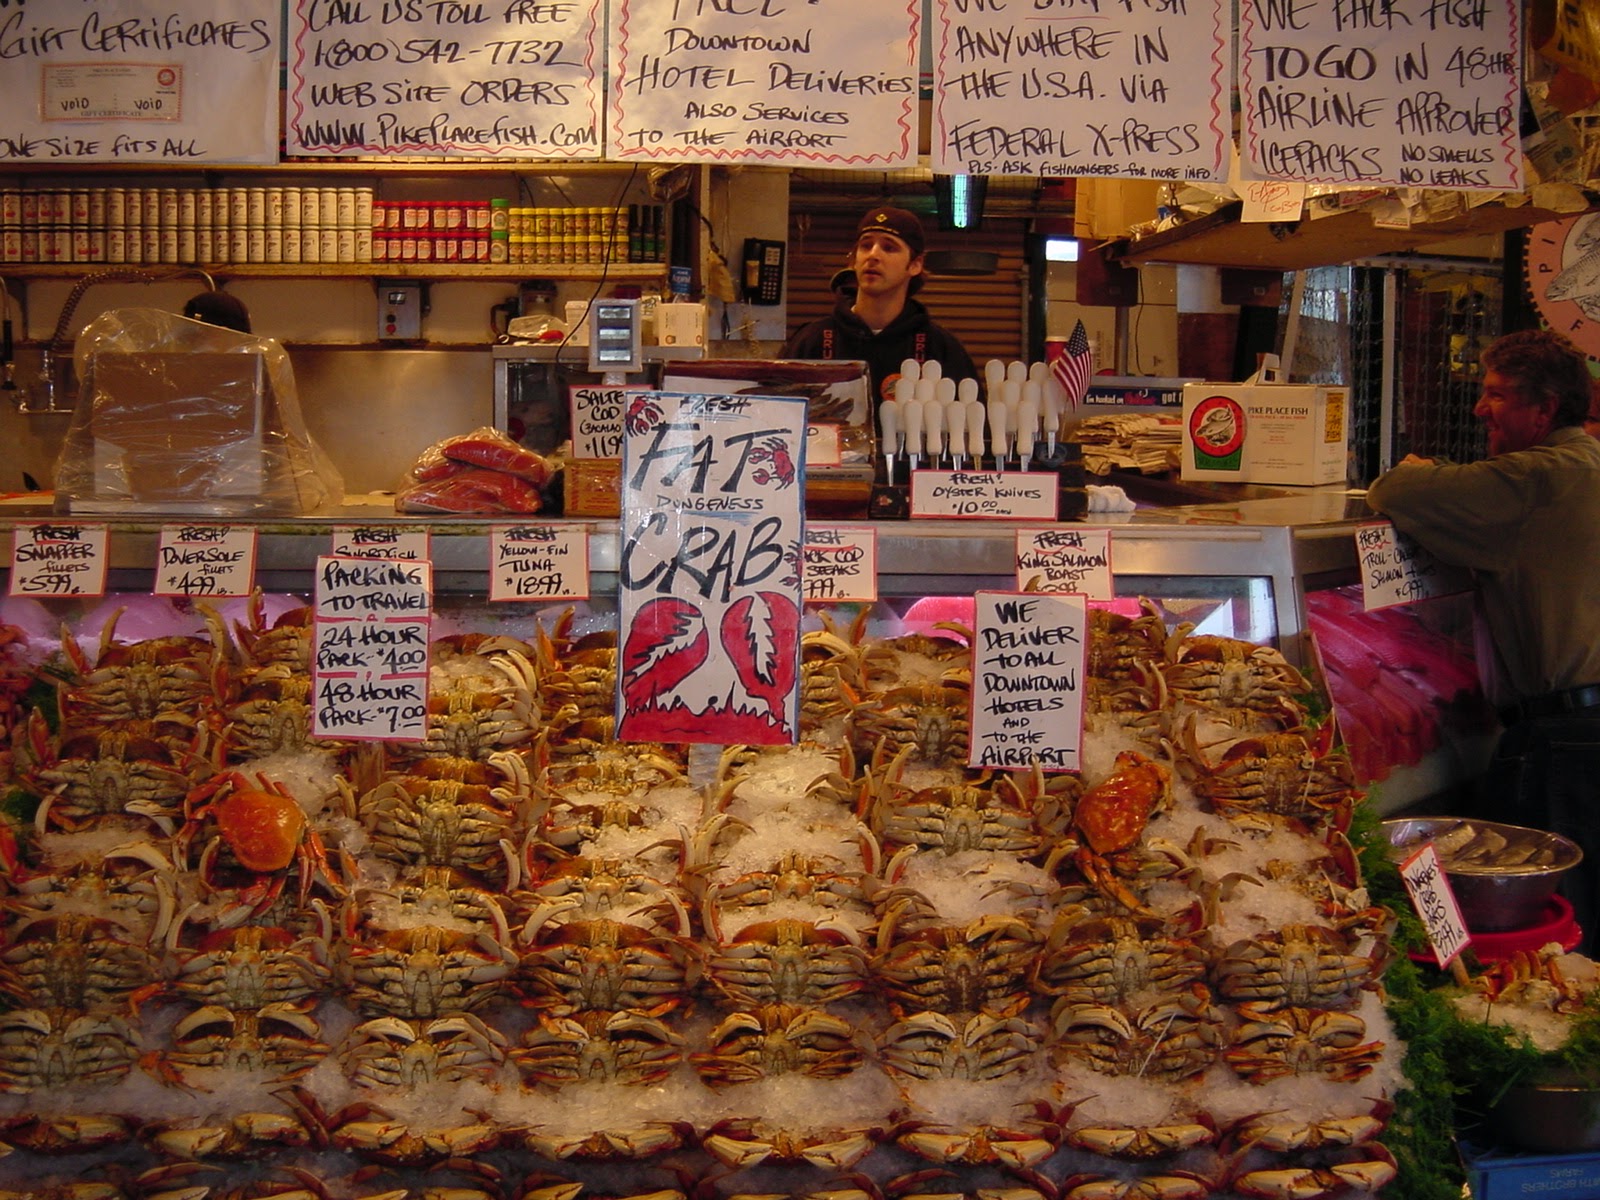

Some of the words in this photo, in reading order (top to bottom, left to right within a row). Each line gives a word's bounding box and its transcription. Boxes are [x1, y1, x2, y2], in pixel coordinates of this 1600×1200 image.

[309, 0, 371, 31] CALL
[382, 0, 422, 24] US
[427, 1, 490, 24] TOLL
[503, 0, 579, 25] FREE
[1255, 0, 1318, 31] WE
[664, 28, 812, 56] DOWNTOWN
[955, 25, 1121, 62] ANYWHERE
[1135, 27, 1169, 65] IN
[1248, 46, 1309, 81] TO
[1313, 44, 1377, 81] GO
[1395, 42, 1429, 84] IN
[624, 54, 754, 94] HOTEL
[311, 81, 376, 107] WEB
[461, 78, 575, 106] ORDERS
[944, 69, 1013, 100] THE
[684, 102, 737, 119] ALSO
[1396, 91, 1514, 136] APPROVED
[163, 139, 207, 157] ALL
[628, 129, 663, 147] TO
[674, 131, 737, 145] THE
[948, 119, 1080, 161] FEDERAL
[1087, 118, 1200, 156] X-PRESS
[1002, 161, 1032, 174] ASK
[1151, 167, 1180, 179] MORE
[1259, 139, 1384, 181] ICEPACKS
[1401, 144, 1426, 162] NO
[1427, 147, 1494, 164] SMELLS
[1400, 166, 1424, 185] NO
[1429, 168, 1490, 186] LEAKS
[575, 389, 624, 410] SALTE
[591, 405, 620, 421] COD
[1248, 406, 1263, 414] PIKE
[1265, 406, 1289, 415] PLACE
[1291, 407, 1308, 415] FISH
[629, 423, 792, 493] FAT
[657, 495, 764, 511] DUNGENESS
[932, 487, 987, 499] OYSTER
[30, 524, 82, 542] FRESH
[352, 528, 401, 544] FRESH
[504, 526, 559, 540] FRESH
[805, 529, 845, 544] RESH
[1033, 531, 1086, 549] FRESH
[16, 542, 95, 562] SNAPPER
[160, 547, 206, 568] DOVER
[207, 547, 245, 562] SOLE
[620, 512, 783, 603] CRAB
[835, 547, 864, 563] COD
[1016, 552, 1050, 569] KING
[1051, 546, 1107, 567] SALMON
[499, 559, 556, 573] TUNA
[806, 564, 860, 577] STEAKS
[1044, 568, 1094, 581] ROAST
[321, 596, 354, 612] TO
[356, 591, 433, 610] TRAVEL
[995, 600, 1040, 625] WE
[320, 626, 356, 649] 24
[359, 626, 426, 646] HOUR
[1024, 651, 1066, 667] ALL
[983, 668, 1076, 695] DOWNTOWN
[319, 679, 354, 708] 48
[357, 683, 421, 702] HOUR
[983, 696, 1065, 716] HOTELS
[1003, 717, 1030, 729] AND
[982, 731, 1007, 743] TO
[1010, 730, 1046, 744] THE
